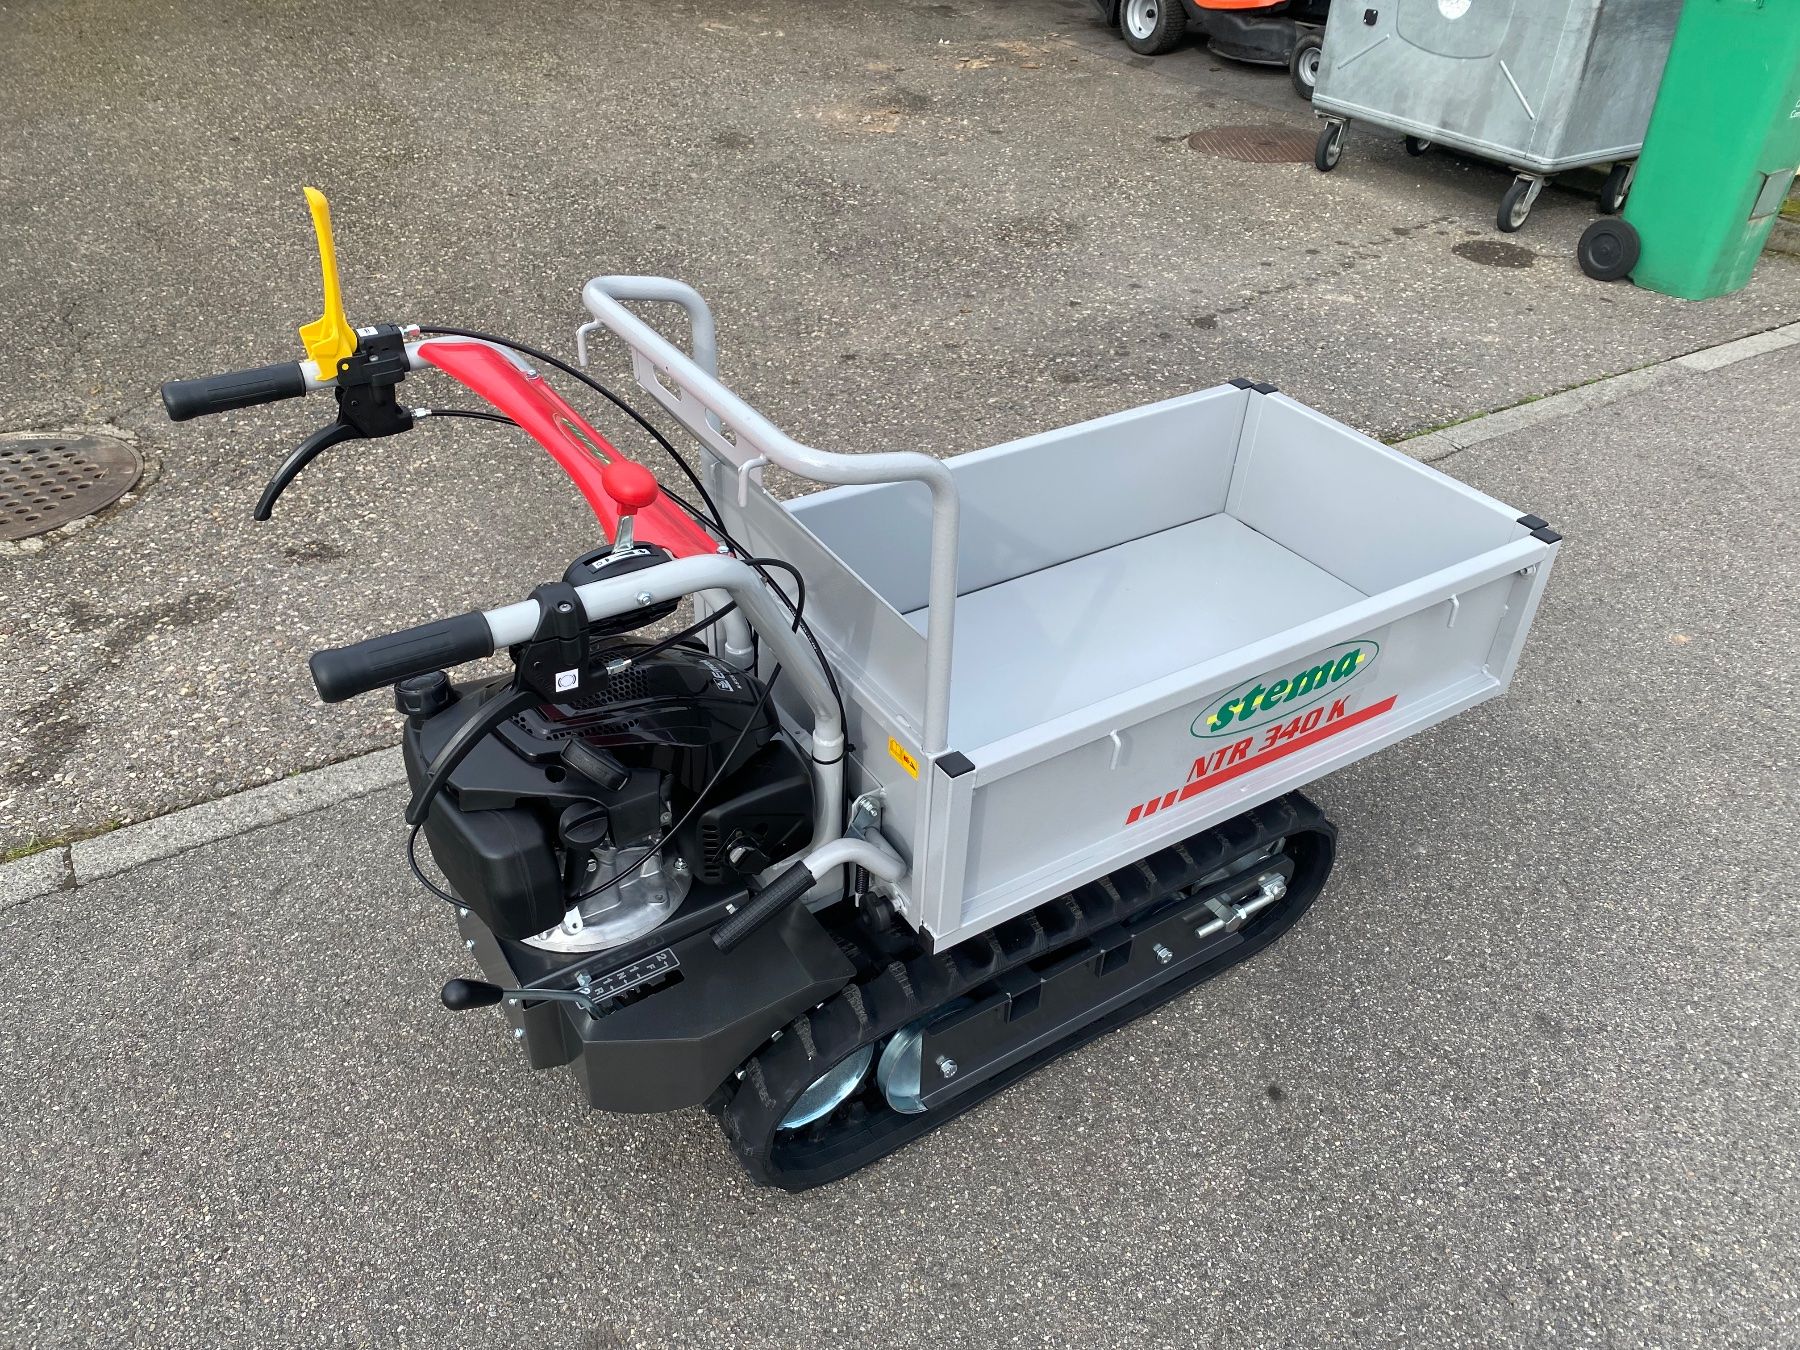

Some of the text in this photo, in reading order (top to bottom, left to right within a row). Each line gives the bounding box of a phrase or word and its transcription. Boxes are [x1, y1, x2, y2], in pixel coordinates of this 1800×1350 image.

[1210, 647, 1361, 733] stema
[1186, 694, 1351, 782] NTR 340 K
[655, 953, 667, 962] 2
[616, 971, 627, 980] N
[594, 987, 605, 996] R
